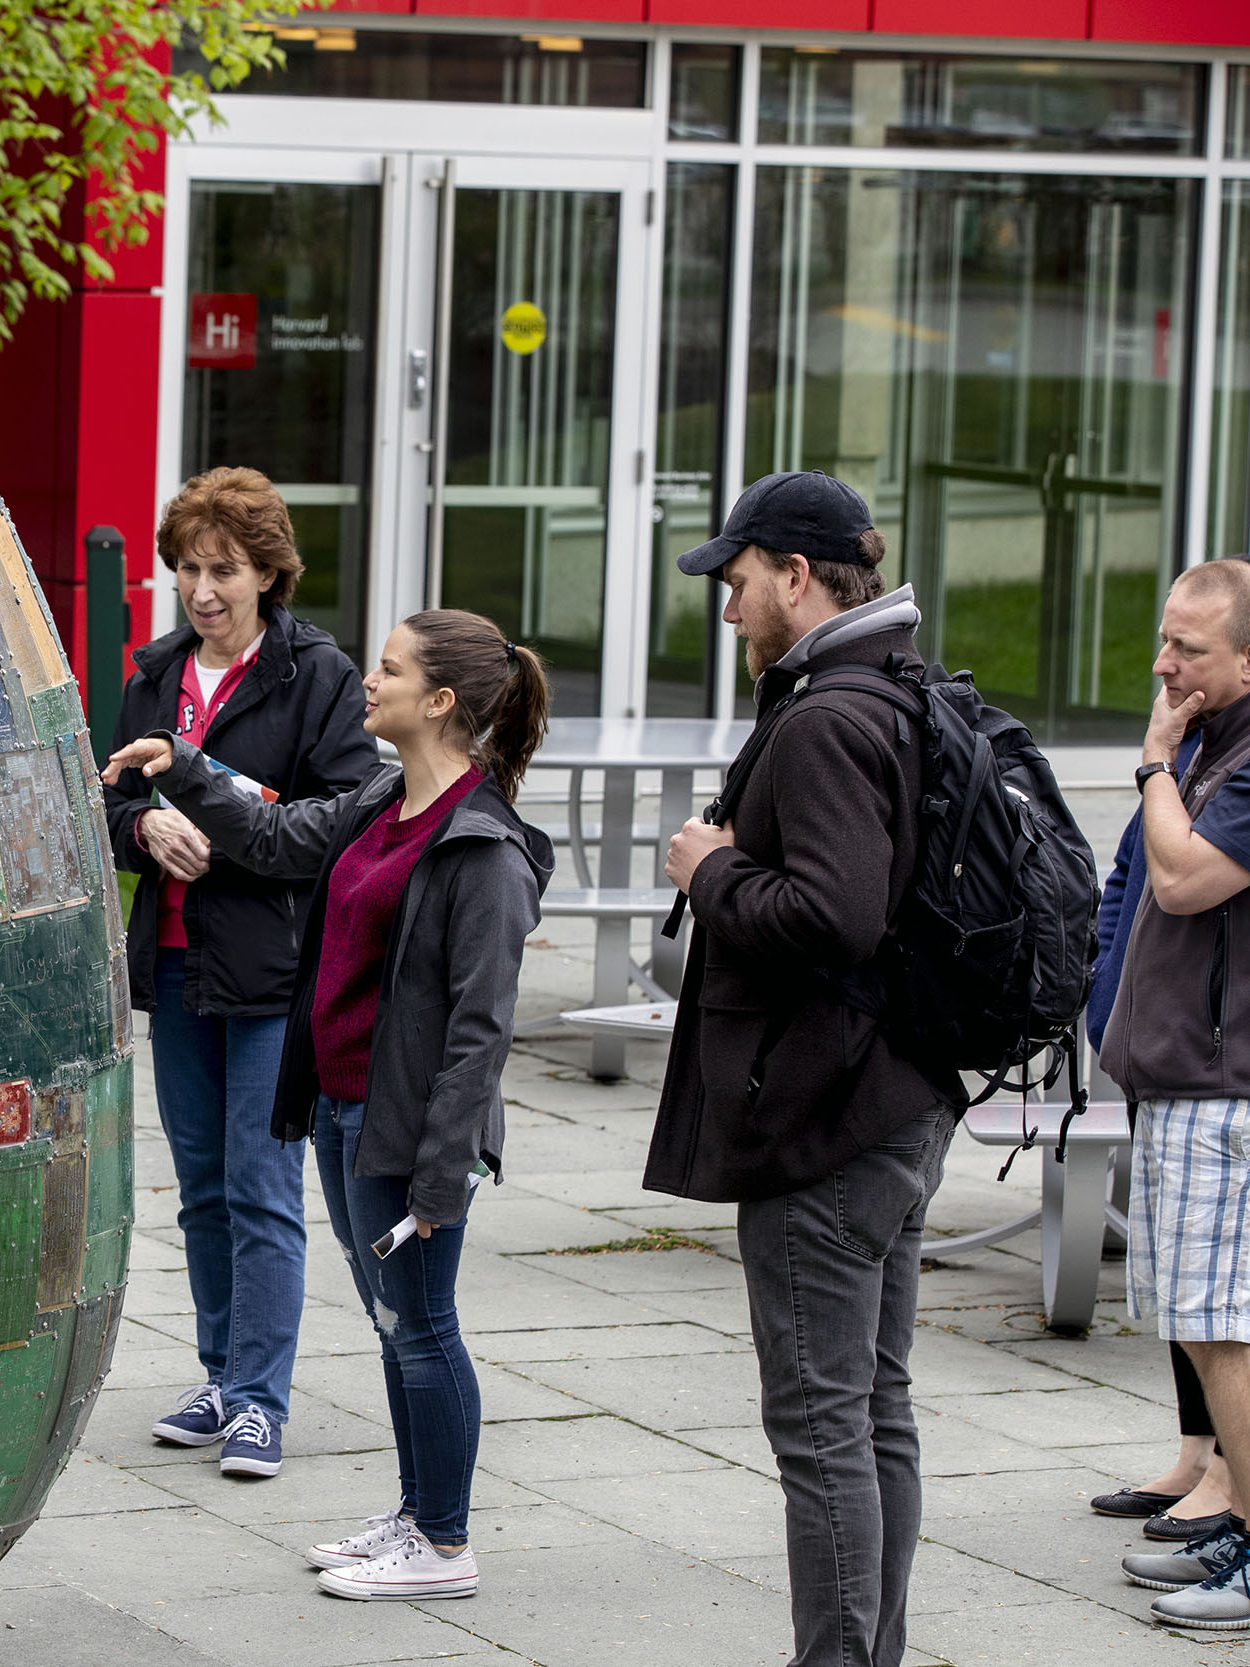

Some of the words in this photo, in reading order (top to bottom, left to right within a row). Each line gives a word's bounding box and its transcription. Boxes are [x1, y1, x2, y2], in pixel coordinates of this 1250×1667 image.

[206, 313, 240, 350] Hi
[271, 314, 329, 333] Harvard
[271, 335, 339, 351] innovation
[341, 332, 365, 351] lab
